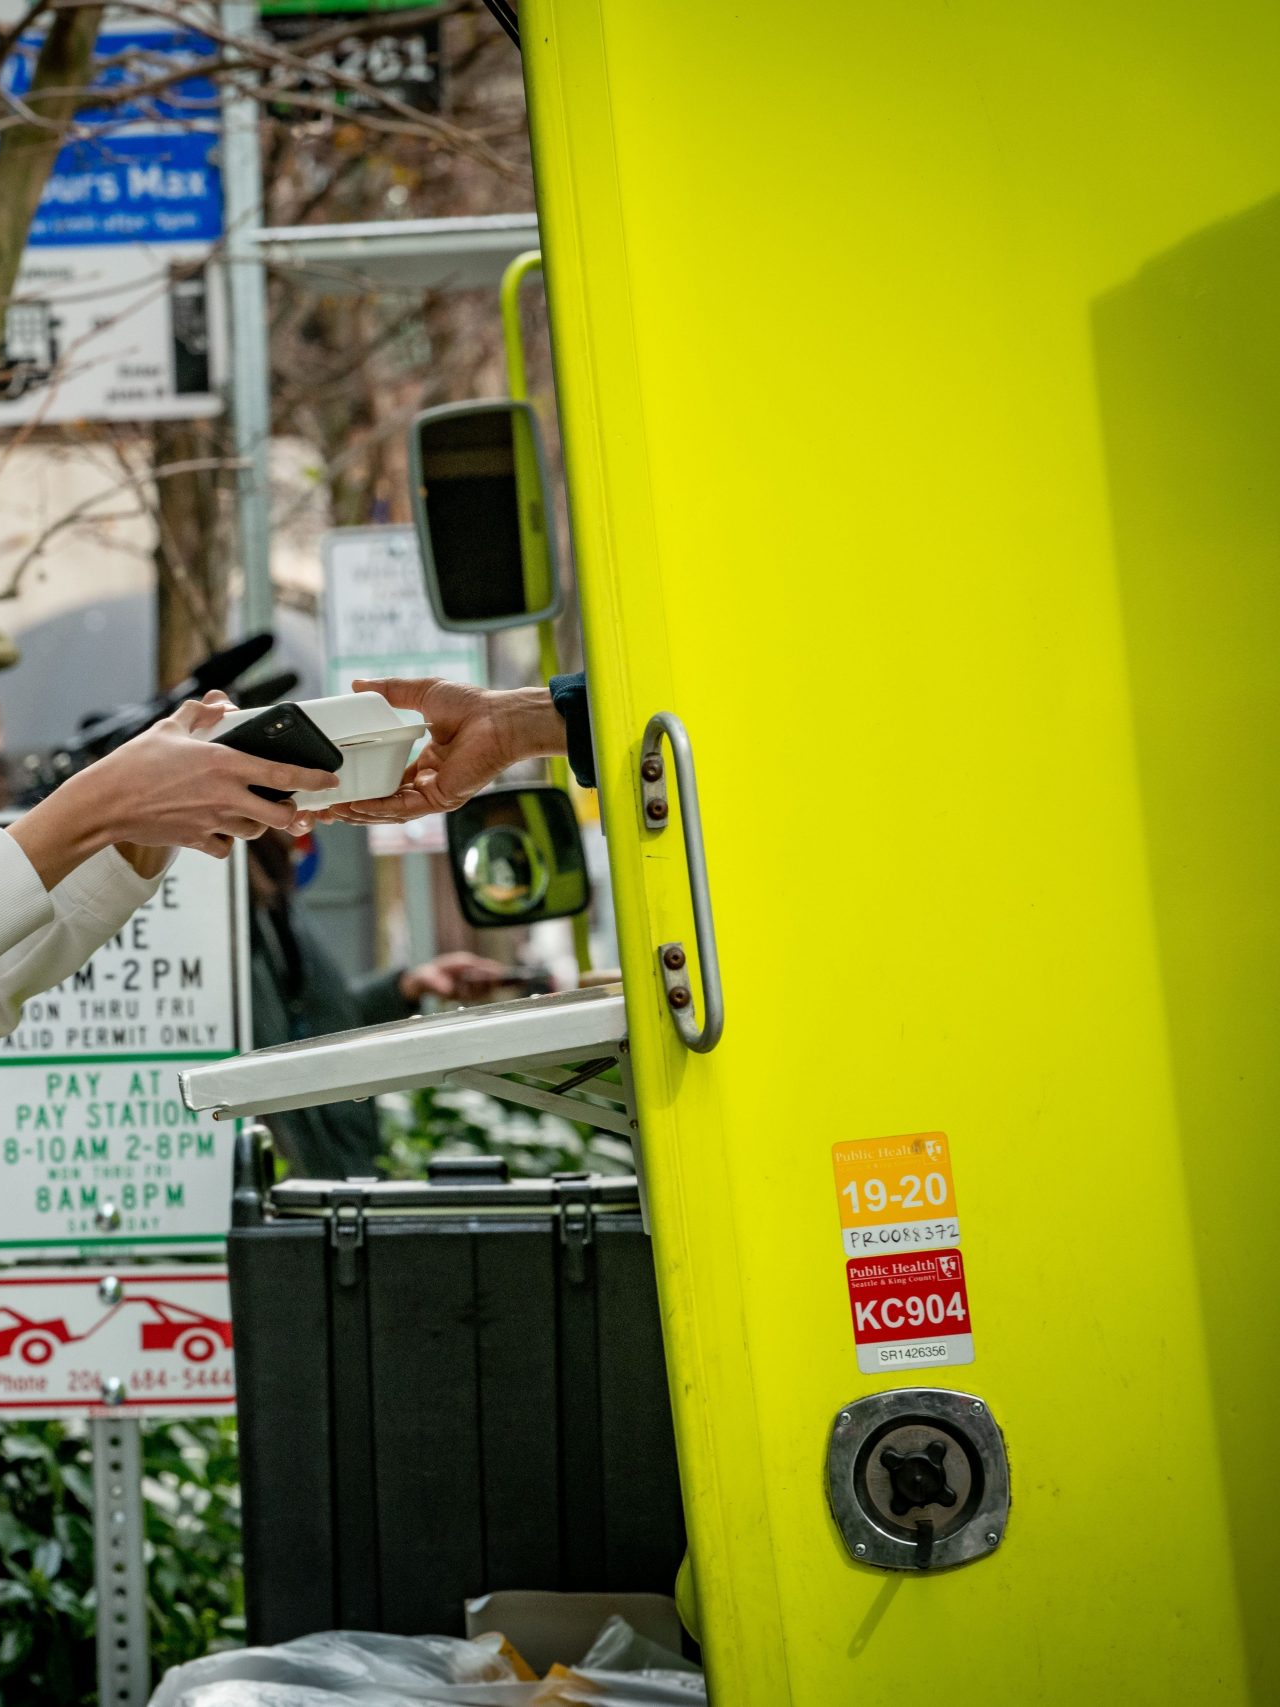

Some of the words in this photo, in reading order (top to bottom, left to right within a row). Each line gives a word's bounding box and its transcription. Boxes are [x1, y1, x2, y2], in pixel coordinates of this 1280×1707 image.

[79, 997, 140, 1021] THRU
[156, 996, 195, 1019] FRI
[66, 1026, 148, 1048] PERMIT
[161, 1024, 219, 1046] ONLY
[47, 1072, 102, 1099] PAY
[129, 1069, 162, 1097] AT
[16, 1104, 68, 1131] PAY
[86, 1101, 200, 1130] STATION
[3, 1135, 109, 1165] 8-10AM
[125, 1131, 215, 1161] 2-8PM
[835, 1150, 873, 1163] Public
[35, 1183, 185, 1213] 8AM-8PM
[842, 1172, 947, 1214] 19-20
[67, 1216, 161, 1233] SADAY
[849, 1265, 889, 1279] Public
[892, 1259, 936, 1273] Health
[851, 1280, 878, 1289] Seattle
[888, 1277, 907, 1287] King
[908, 1274, 936, 1283] County
[854, 1291, 966, 1332] KC904
[880, 1345, 946, 1362] SR1426356
[68, 1370, 103, 1392] 206
[130, 1368, 233, 1391] 684-5444
